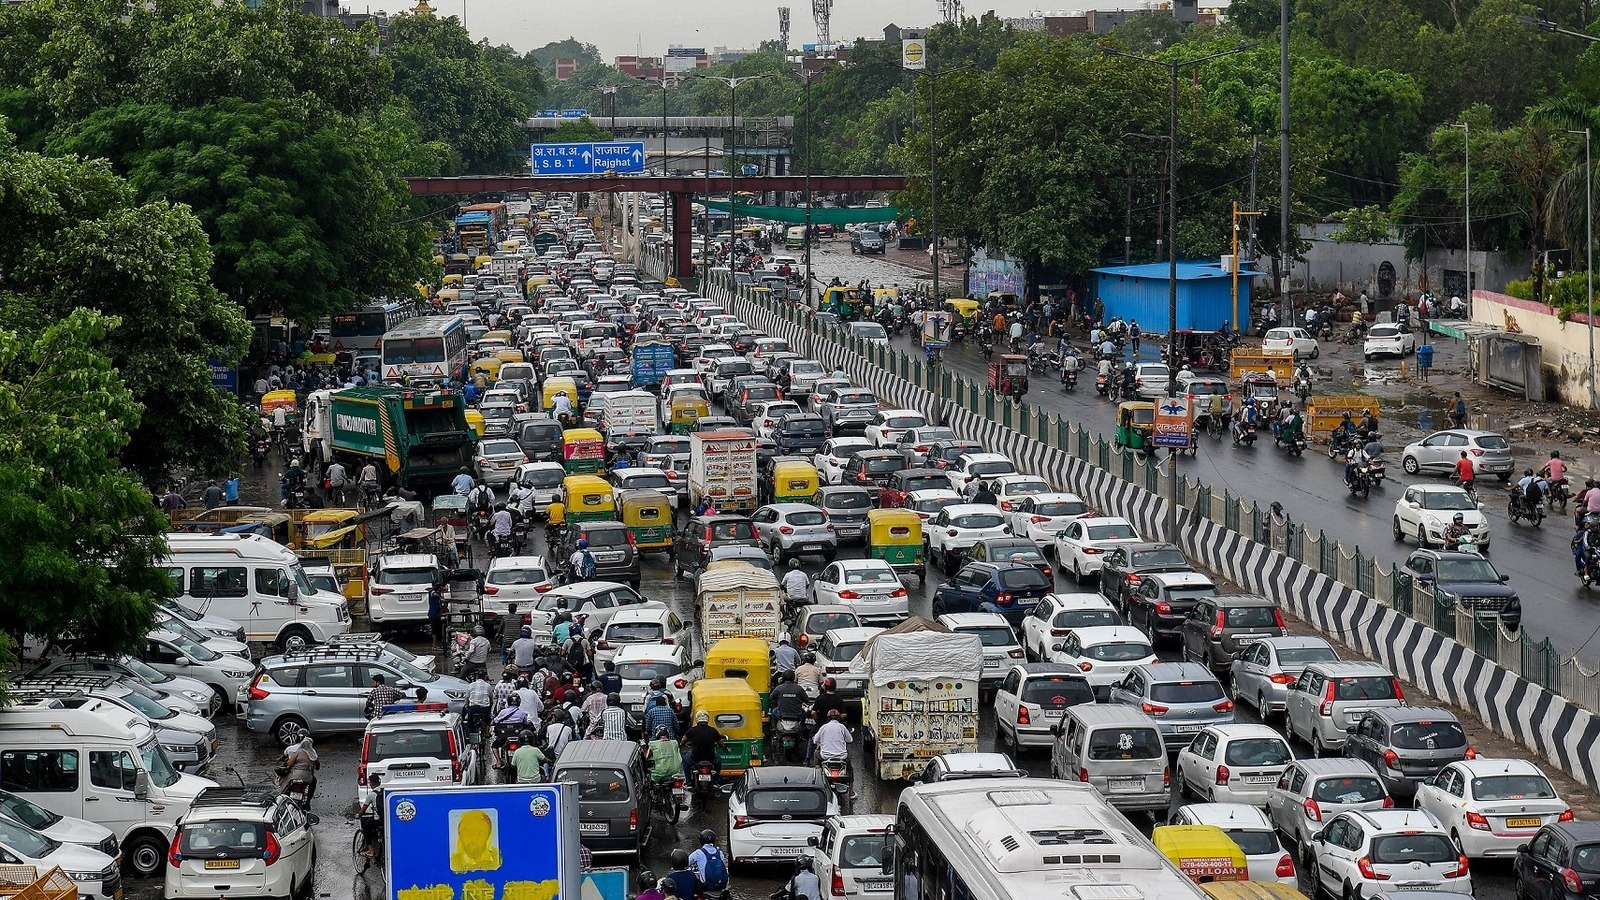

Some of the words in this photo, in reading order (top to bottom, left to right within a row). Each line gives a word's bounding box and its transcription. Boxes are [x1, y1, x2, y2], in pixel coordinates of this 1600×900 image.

[595, 146, 630, 155] राजघाट
[594, 159, 631, 169] Rajghat
[881, 697, 925, 712] BLOW
[928, 698, 972, 712] HORN
